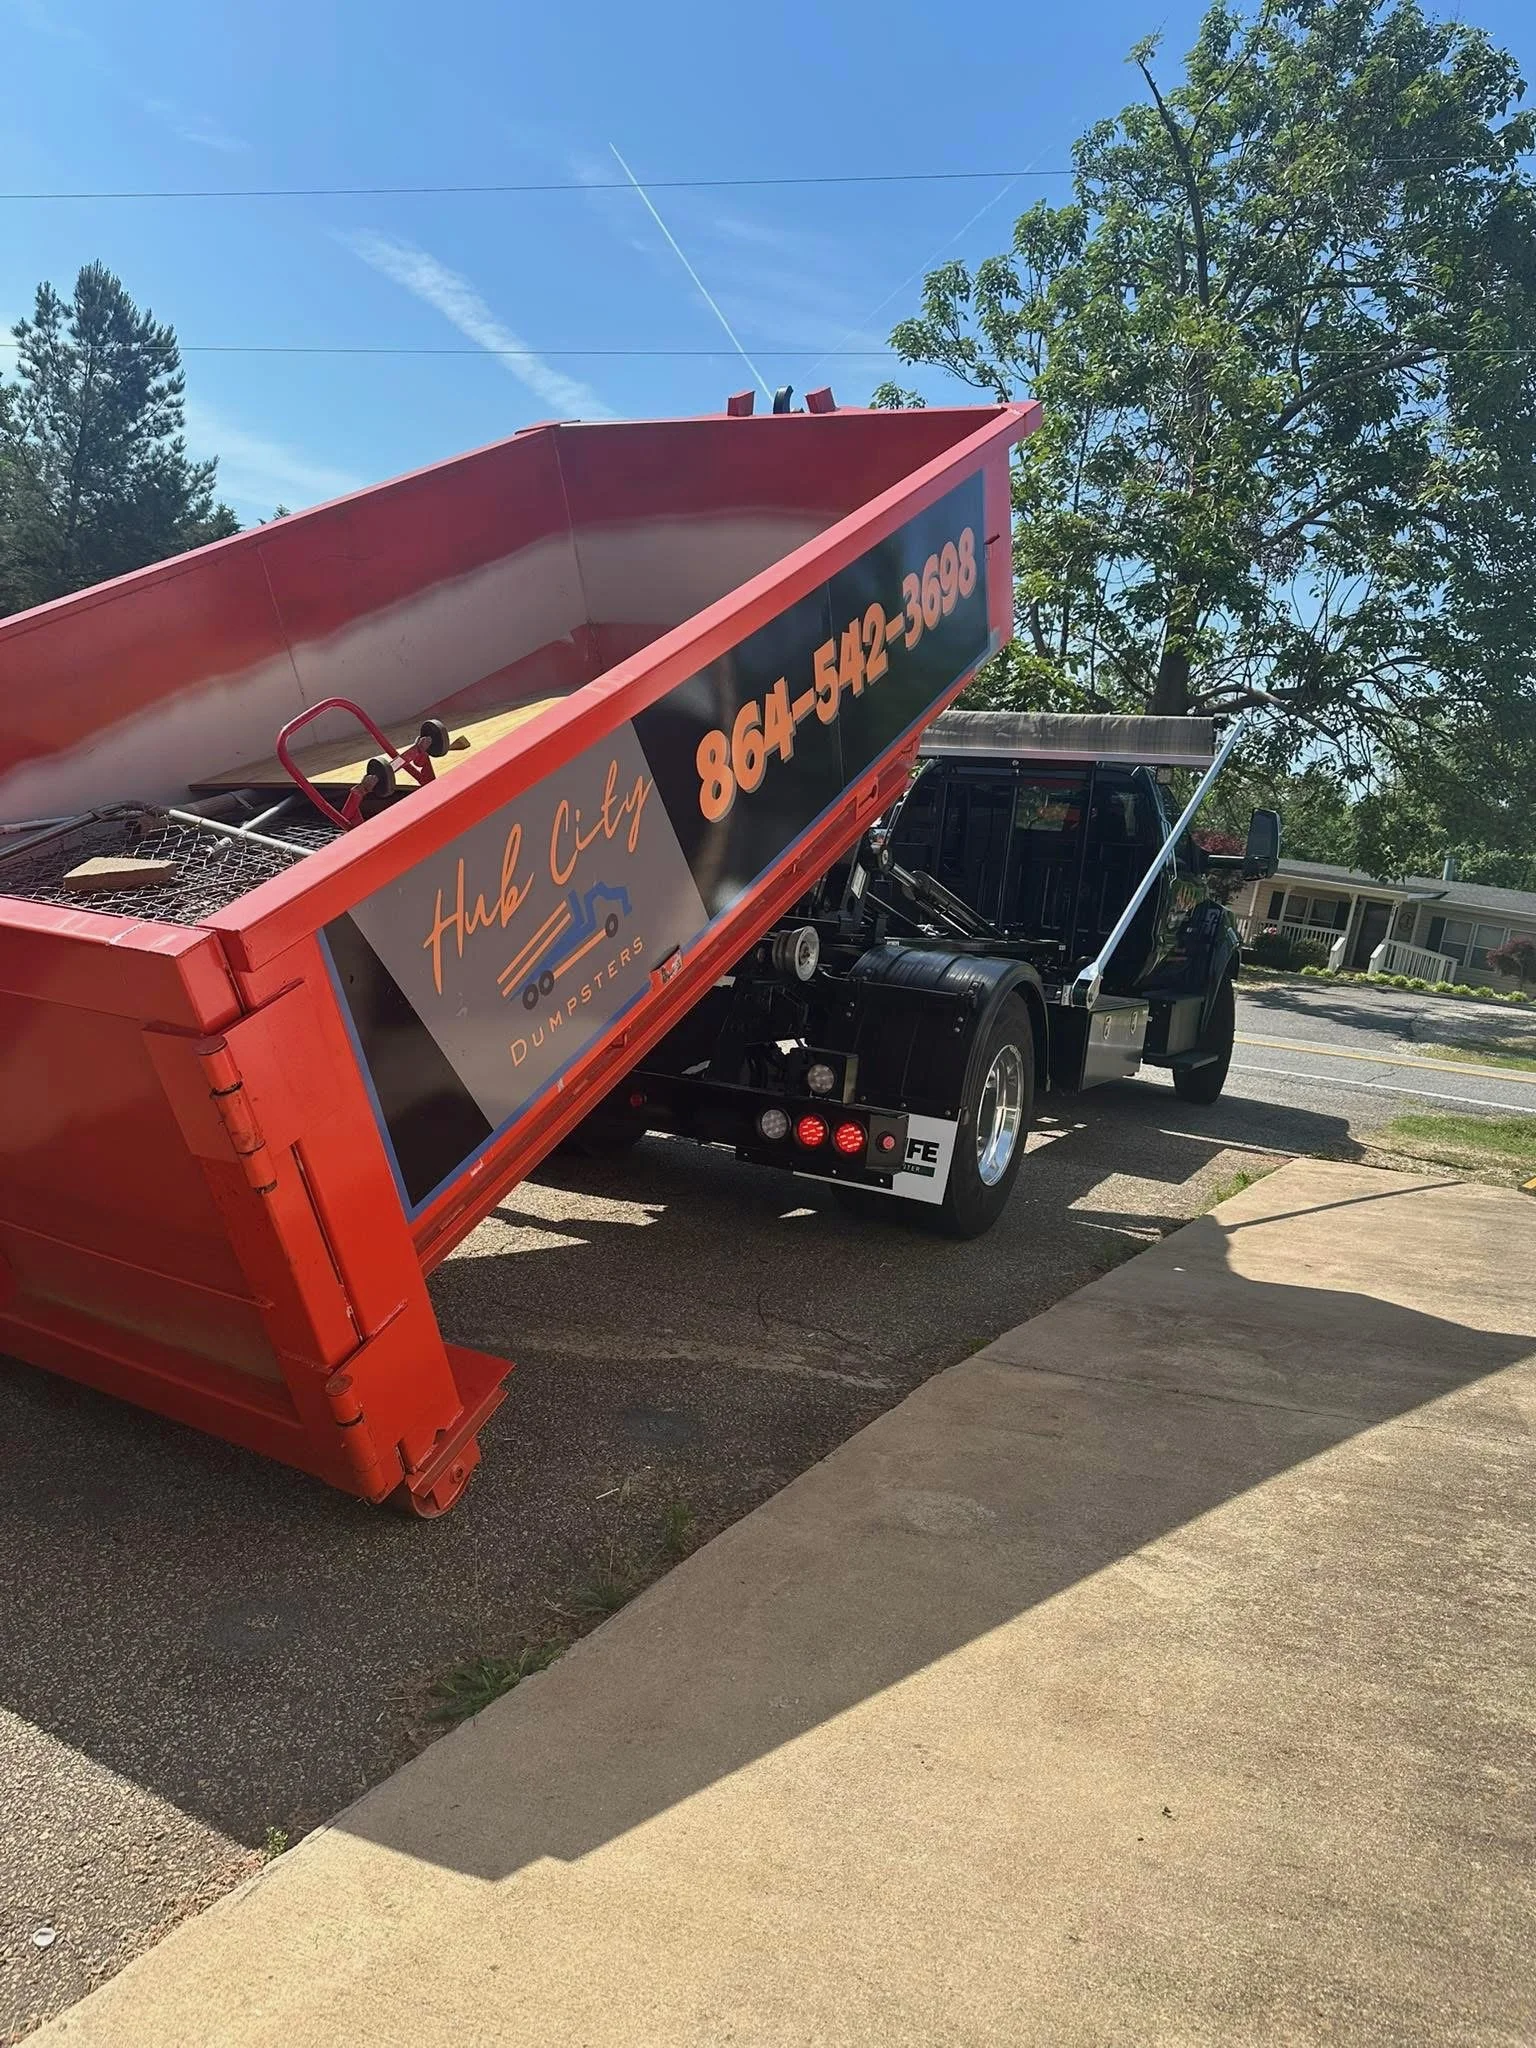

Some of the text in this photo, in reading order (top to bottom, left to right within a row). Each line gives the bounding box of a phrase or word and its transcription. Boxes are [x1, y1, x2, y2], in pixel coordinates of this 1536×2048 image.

[696, 527, 978, 824] 864-542-3698
[423, 759, 654, 996] Hub City
[509, 936, 644, 1067] DUMPSTERS
[905, 1137, 940, 1164] FE
